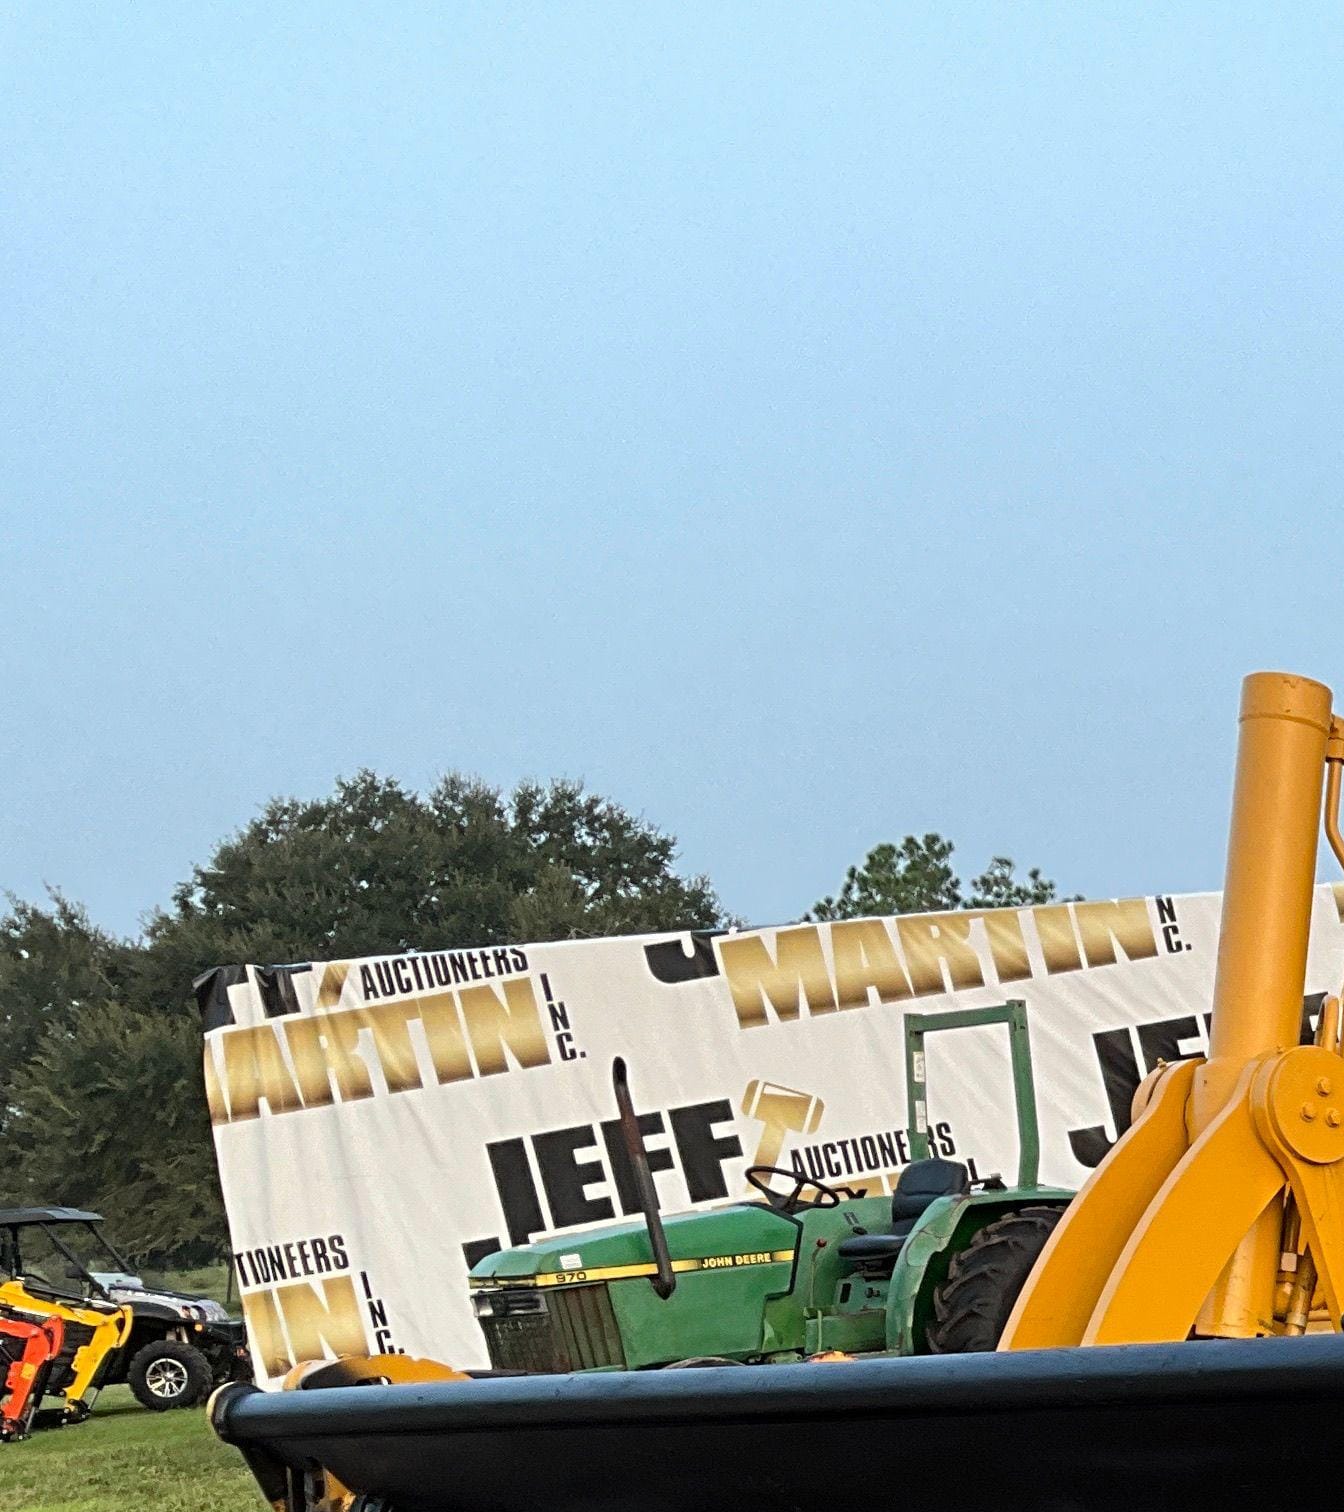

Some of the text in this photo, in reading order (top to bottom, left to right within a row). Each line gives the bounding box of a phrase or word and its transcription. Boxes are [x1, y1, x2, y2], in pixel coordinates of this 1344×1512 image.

[1155, 895, 1192, 954] NC.
[360, 947, 530, 1001] AUCTIONEERS
[718, 898, 1158, 1030] MARTIN
[203, 977, 552, 1127] ARTIN
[790, 1122, 956, 1183] AUCTIONERS
[461, 1098, 744, 1271] JEFF
[235, 1234, 349, 1288] TIONEERS
[556, 1271, 587, 1283] 970
[702, 1252, 771, 1269] JOHN DEERE
